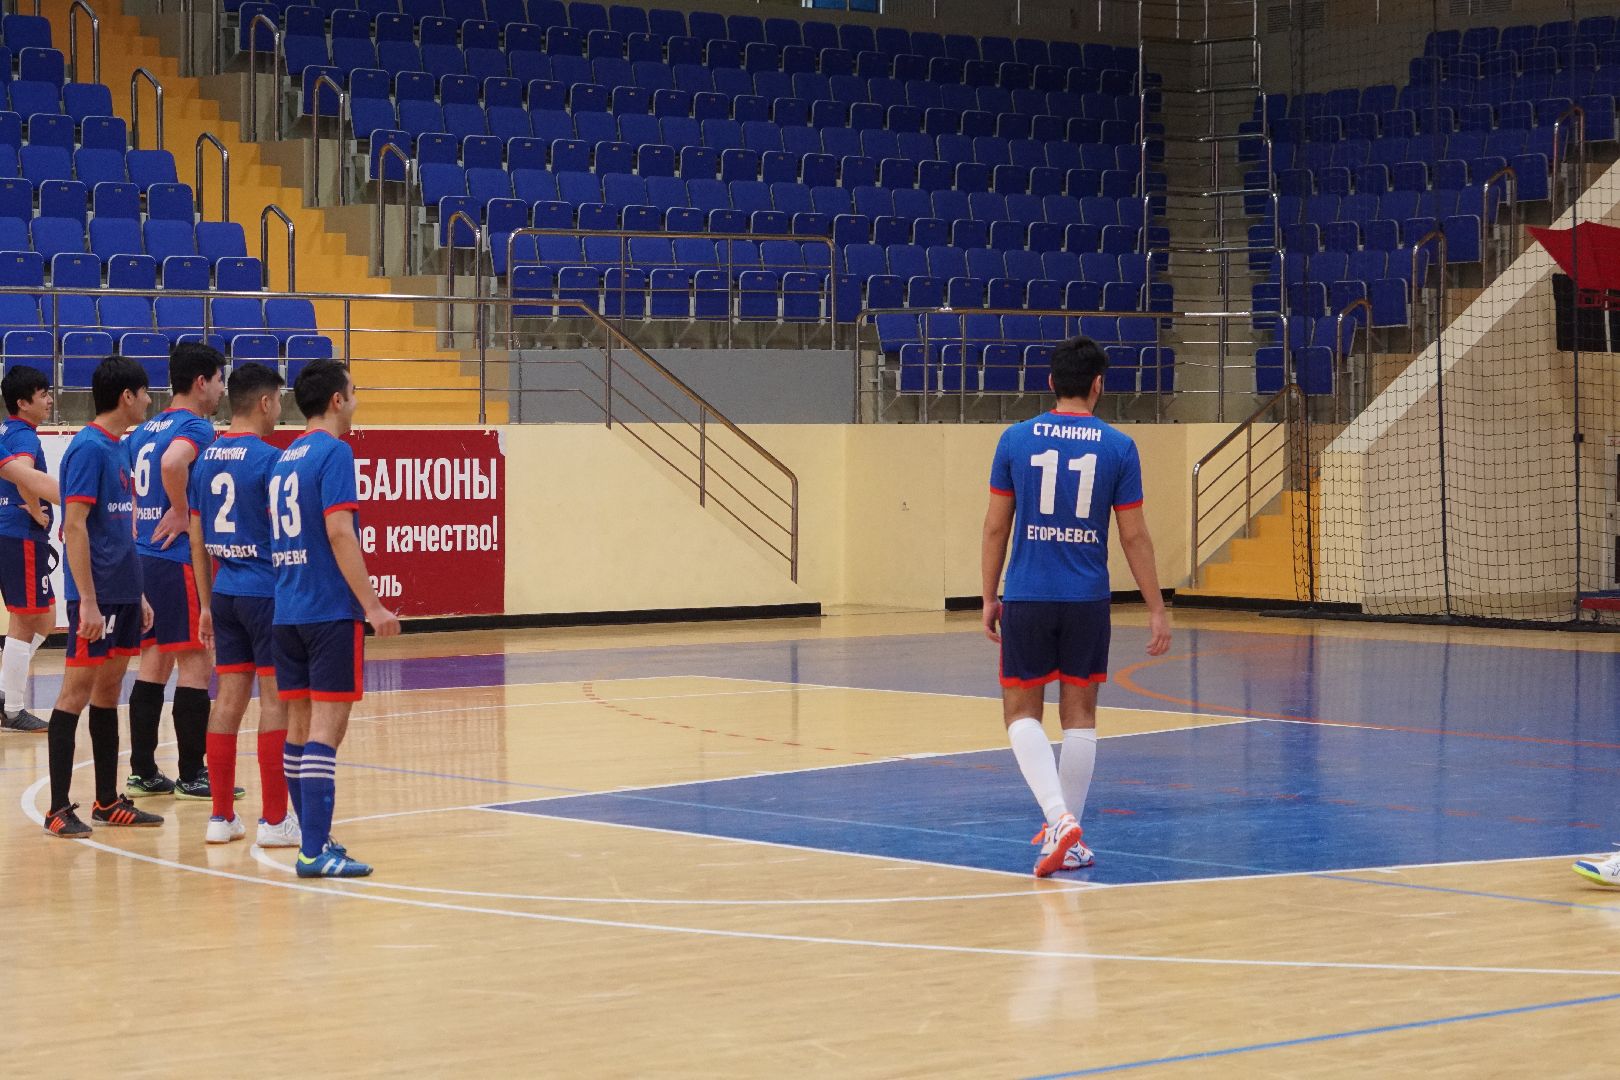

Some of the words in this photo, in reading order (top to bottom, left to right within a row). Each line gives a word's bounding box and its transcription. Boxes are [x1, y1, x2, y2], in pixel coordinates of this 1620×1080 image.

[1033, 422, 1102, 442] СТАНКИН
[135, 442, 156, 497] 6
[353, 457, 497, 501] БАЛКОНЫ
[1030, 449, 1098, 519] 11
[210, 472, 236, 533] 2
[268, 471, 302, 540] 13
[386, 515, 498, 553] качество!
[1027, 525, 1099, 543] ЕГОРЬЕВСК
[41, 575, 49, 595] 9
